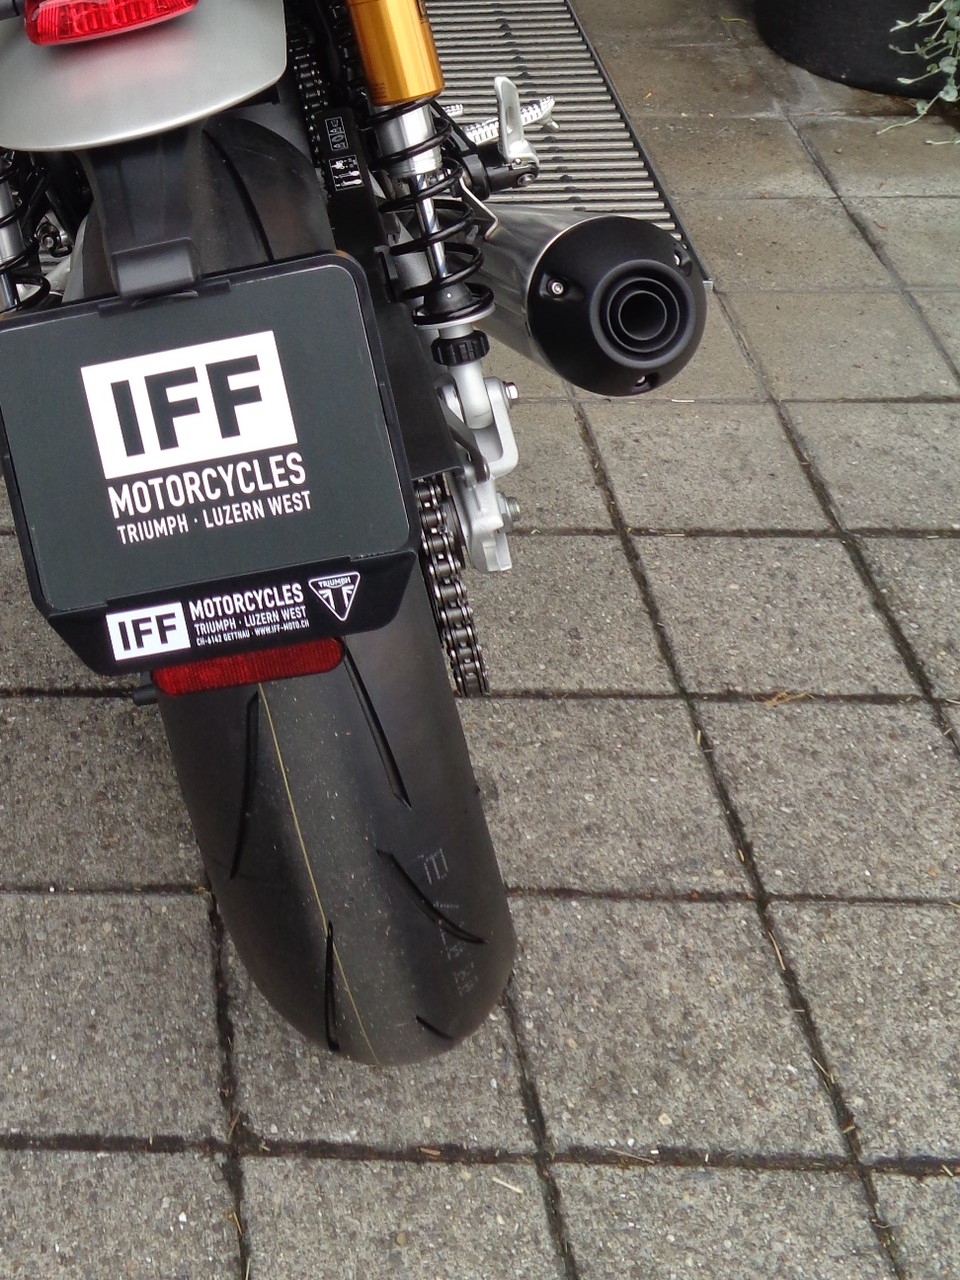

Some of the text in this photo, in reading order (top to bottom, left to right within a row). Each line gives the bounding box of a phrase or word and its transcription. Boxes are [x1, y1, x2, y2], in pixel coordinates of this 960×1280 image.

[110, 354, 263, 458] IFF
[107, 451, 307, 520] MOTORCYCLES
[117, 490, 313, 545] TRIUMPH LUZERN WEST
[318, 576, 352, 589] TRIUMPH
[188, 583, 305, 622] MOTORCYCLES
[194, 605, 307, 637] TRIUMPH LUZERN WEST
[117, 612, 181, 652] IFF
[196, 633, 223, 647] CH-6142
[254, 619, 310, 638] WWW.IFF-MOTO.CH
